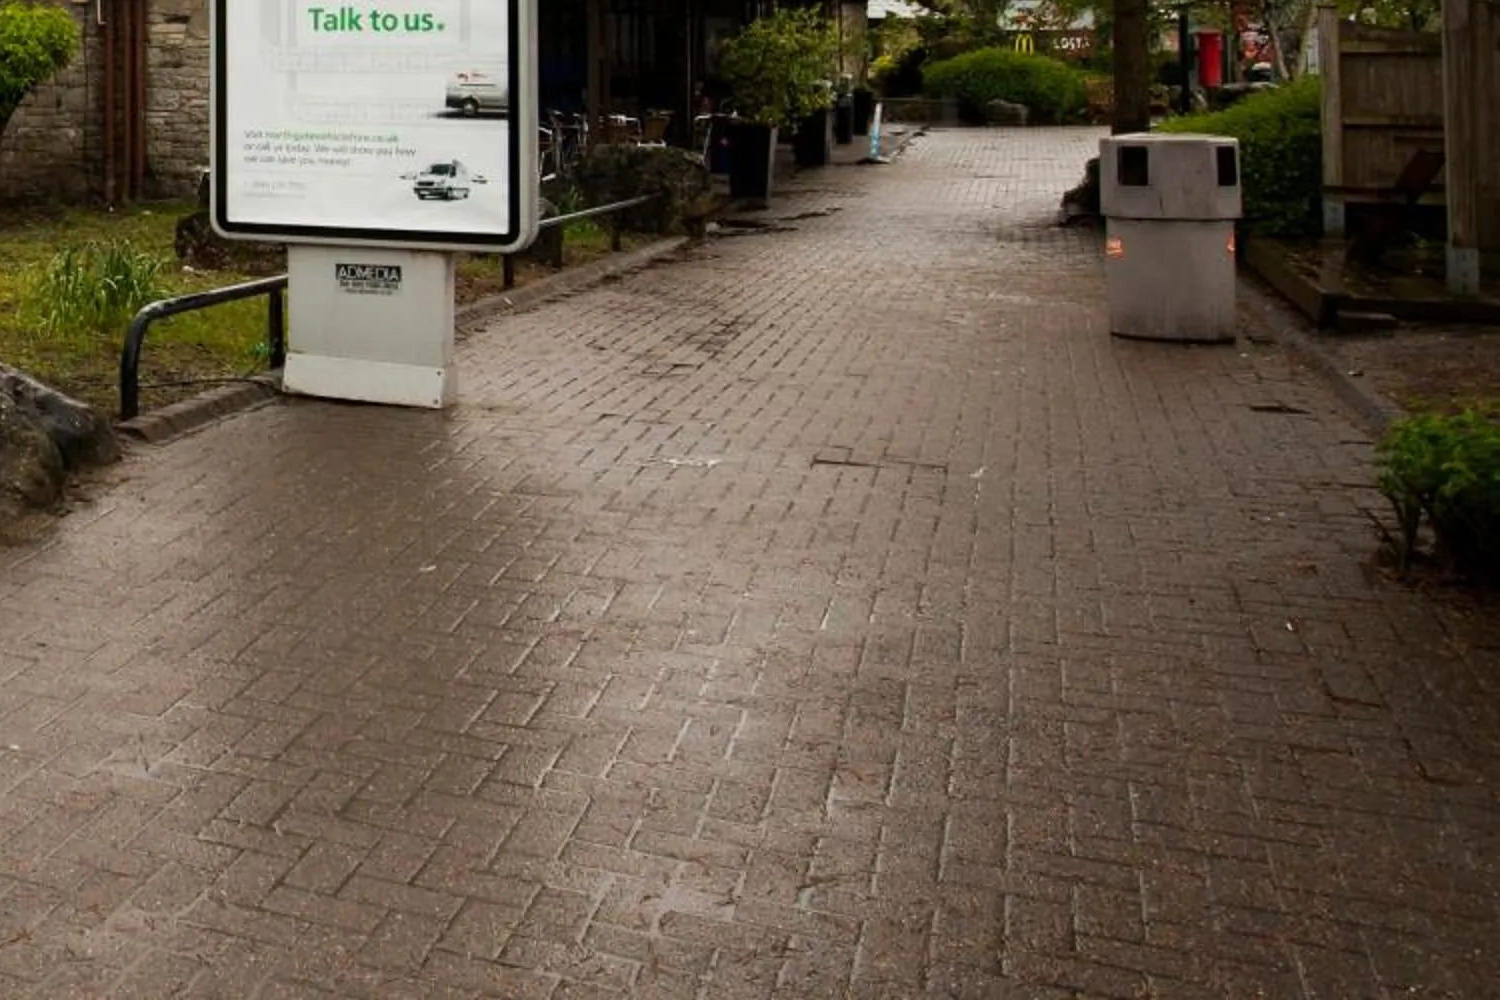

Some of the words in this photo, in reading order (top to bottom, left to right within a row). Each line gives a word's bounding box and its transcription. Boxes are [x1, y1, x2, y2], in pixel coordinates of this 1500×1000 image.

[307, 7, 363, 32] Talk
[370, 10, 398, 32] to
[404, 12, 445, 32] us.
[339, 265, 399, 281] ADMEDIA
